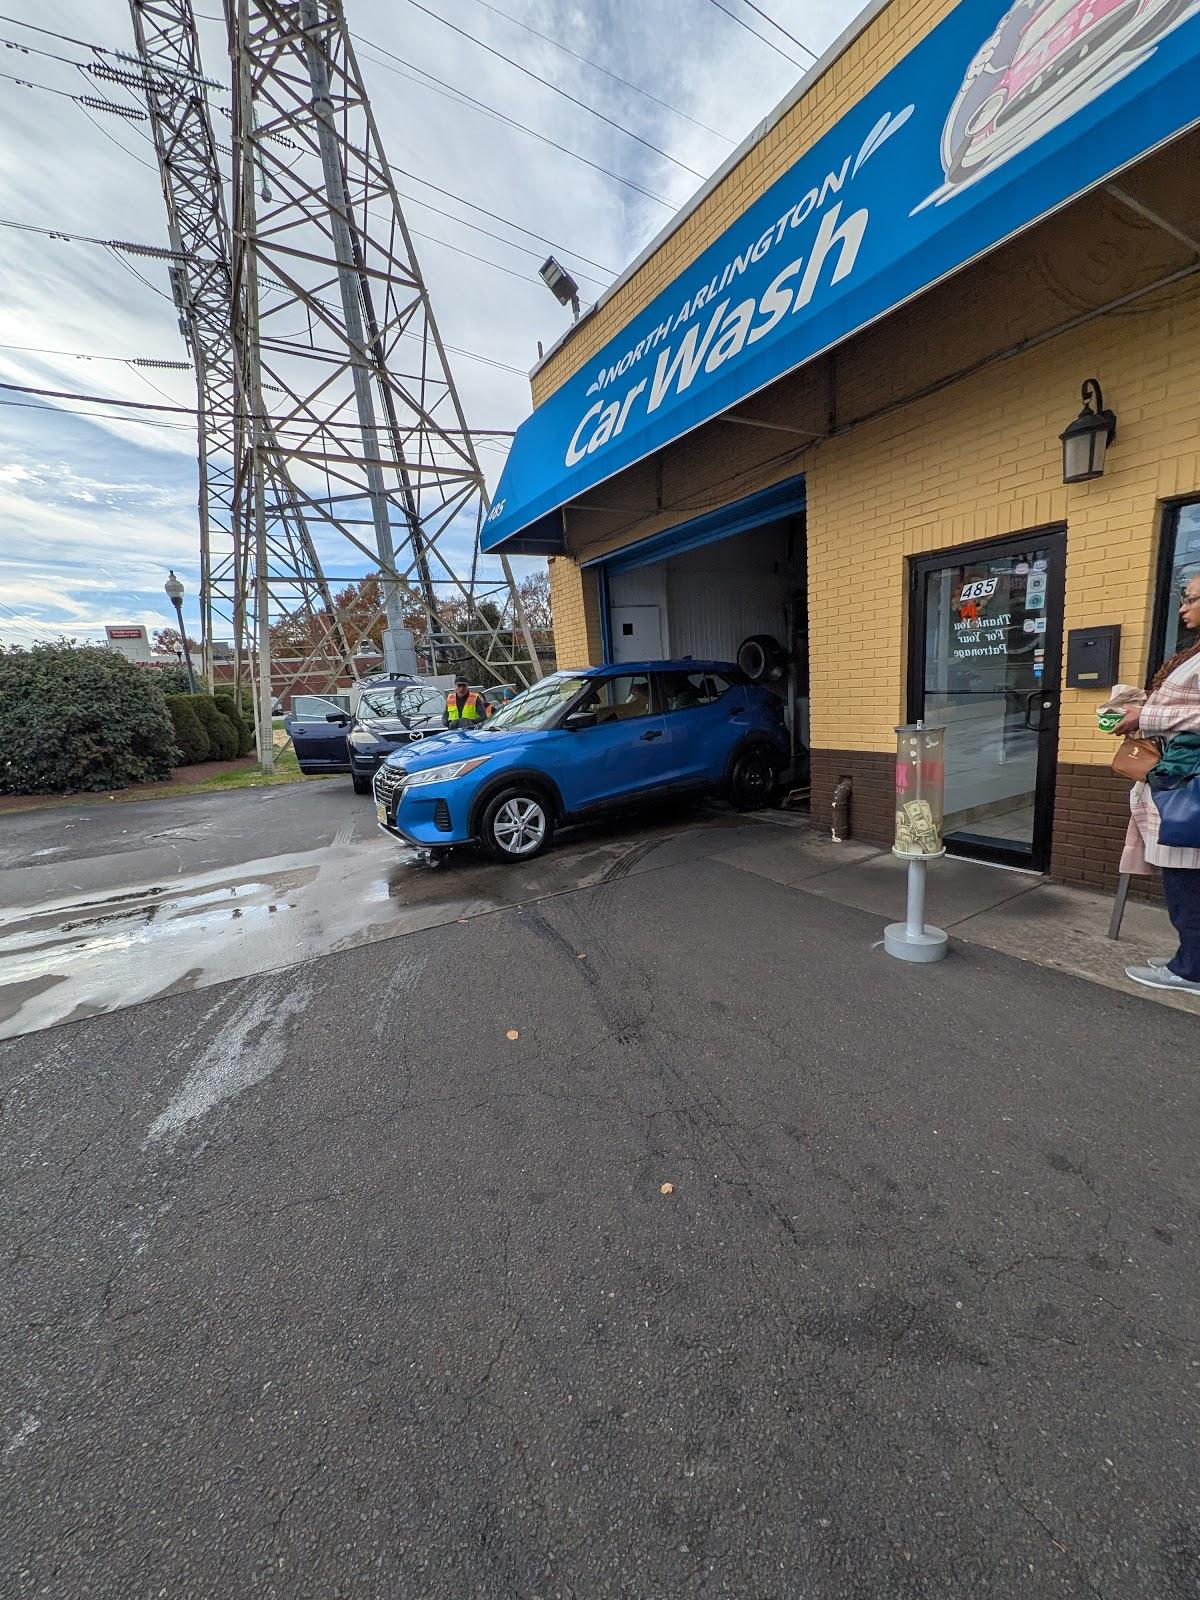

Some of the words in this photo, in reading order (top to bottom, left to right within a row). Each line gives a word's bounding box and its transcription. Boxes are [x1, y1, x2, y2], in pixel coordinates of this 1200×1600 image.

[565, 376, 647, 467] Car
[646, 200, 869, 414] Wash
[603, 314, 674, 389] NORTH
[672, 156, 851, 332] ARLINGTON
[487, 498, 507, 522] 485
[962, 579, 996, 599] 485
